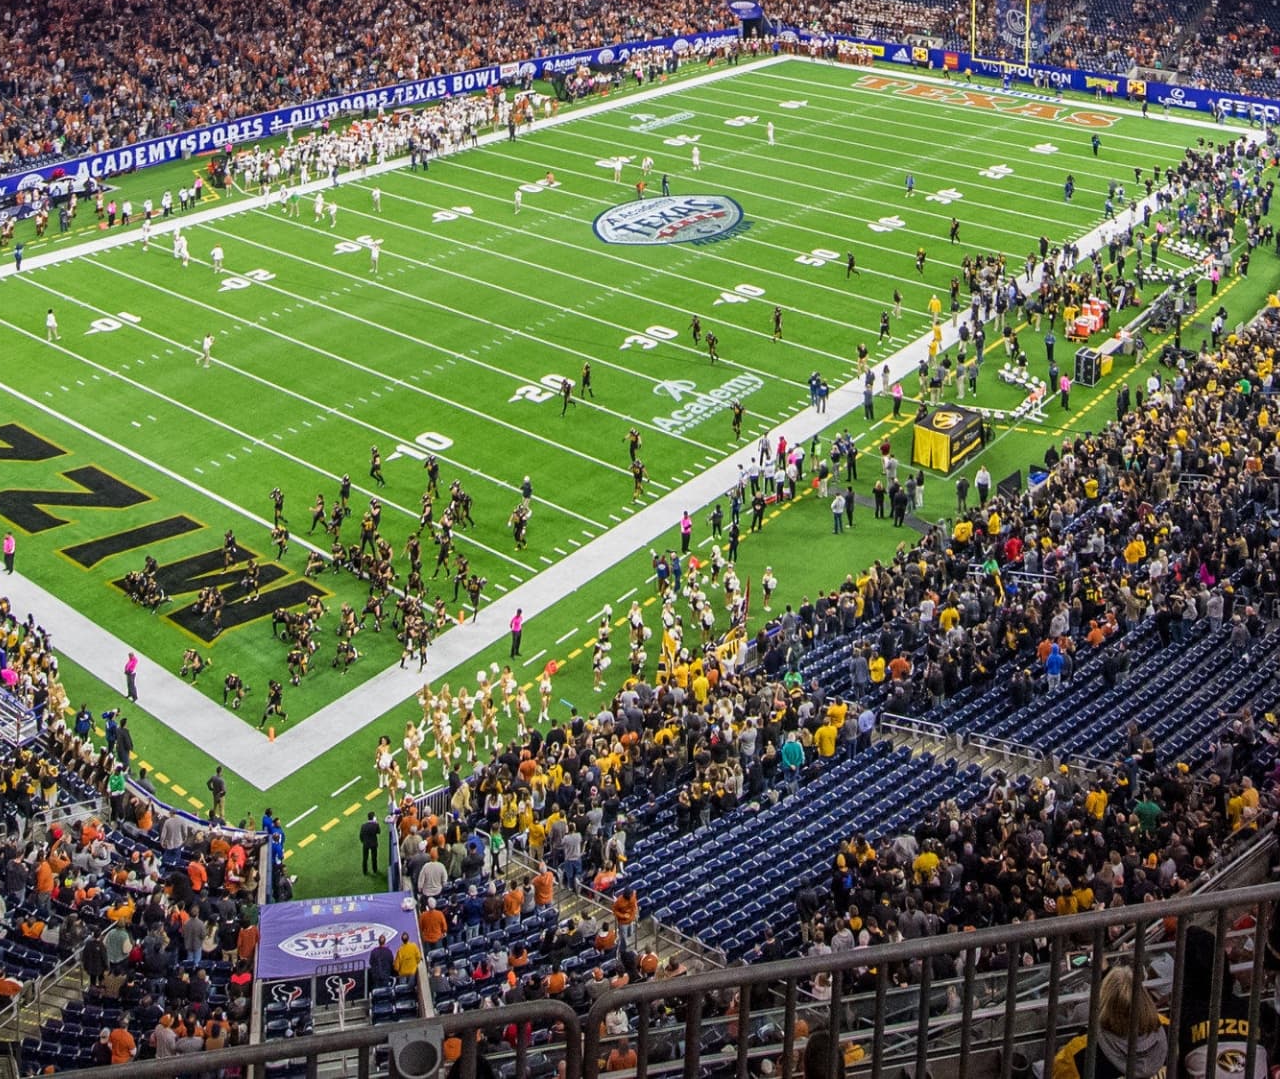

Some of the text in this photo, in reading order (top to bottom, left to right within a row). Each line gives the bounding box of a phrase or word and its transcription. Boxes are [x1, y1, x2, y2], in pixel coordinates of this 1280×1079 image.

[554, 55, 592, 70] Academy
[852, 75, 1122, 128] TEXAS
[1157, 95, 1197, 108] LEXUS
[76, 140, 177, 178] ACADEMY
[181, 118, 264, 153] SPORTS
[394, 79, 447, 103] TEXAS
[453, 68, 499, 93] BOWL
[613, 199, 724, 237] TEXAS
[794, 248, 841, 267] 50
[720, 283, 766, 303] 40
[624, 325, 679, 350] 30
[515, 374, 576, 403] 20
[652, 371, 764, 432] Academy
[396, 431, 454, 460] 10
[294, 930, 378, 952] TEXAS
[1191, 1018, 1261, 1043] MIZZO
